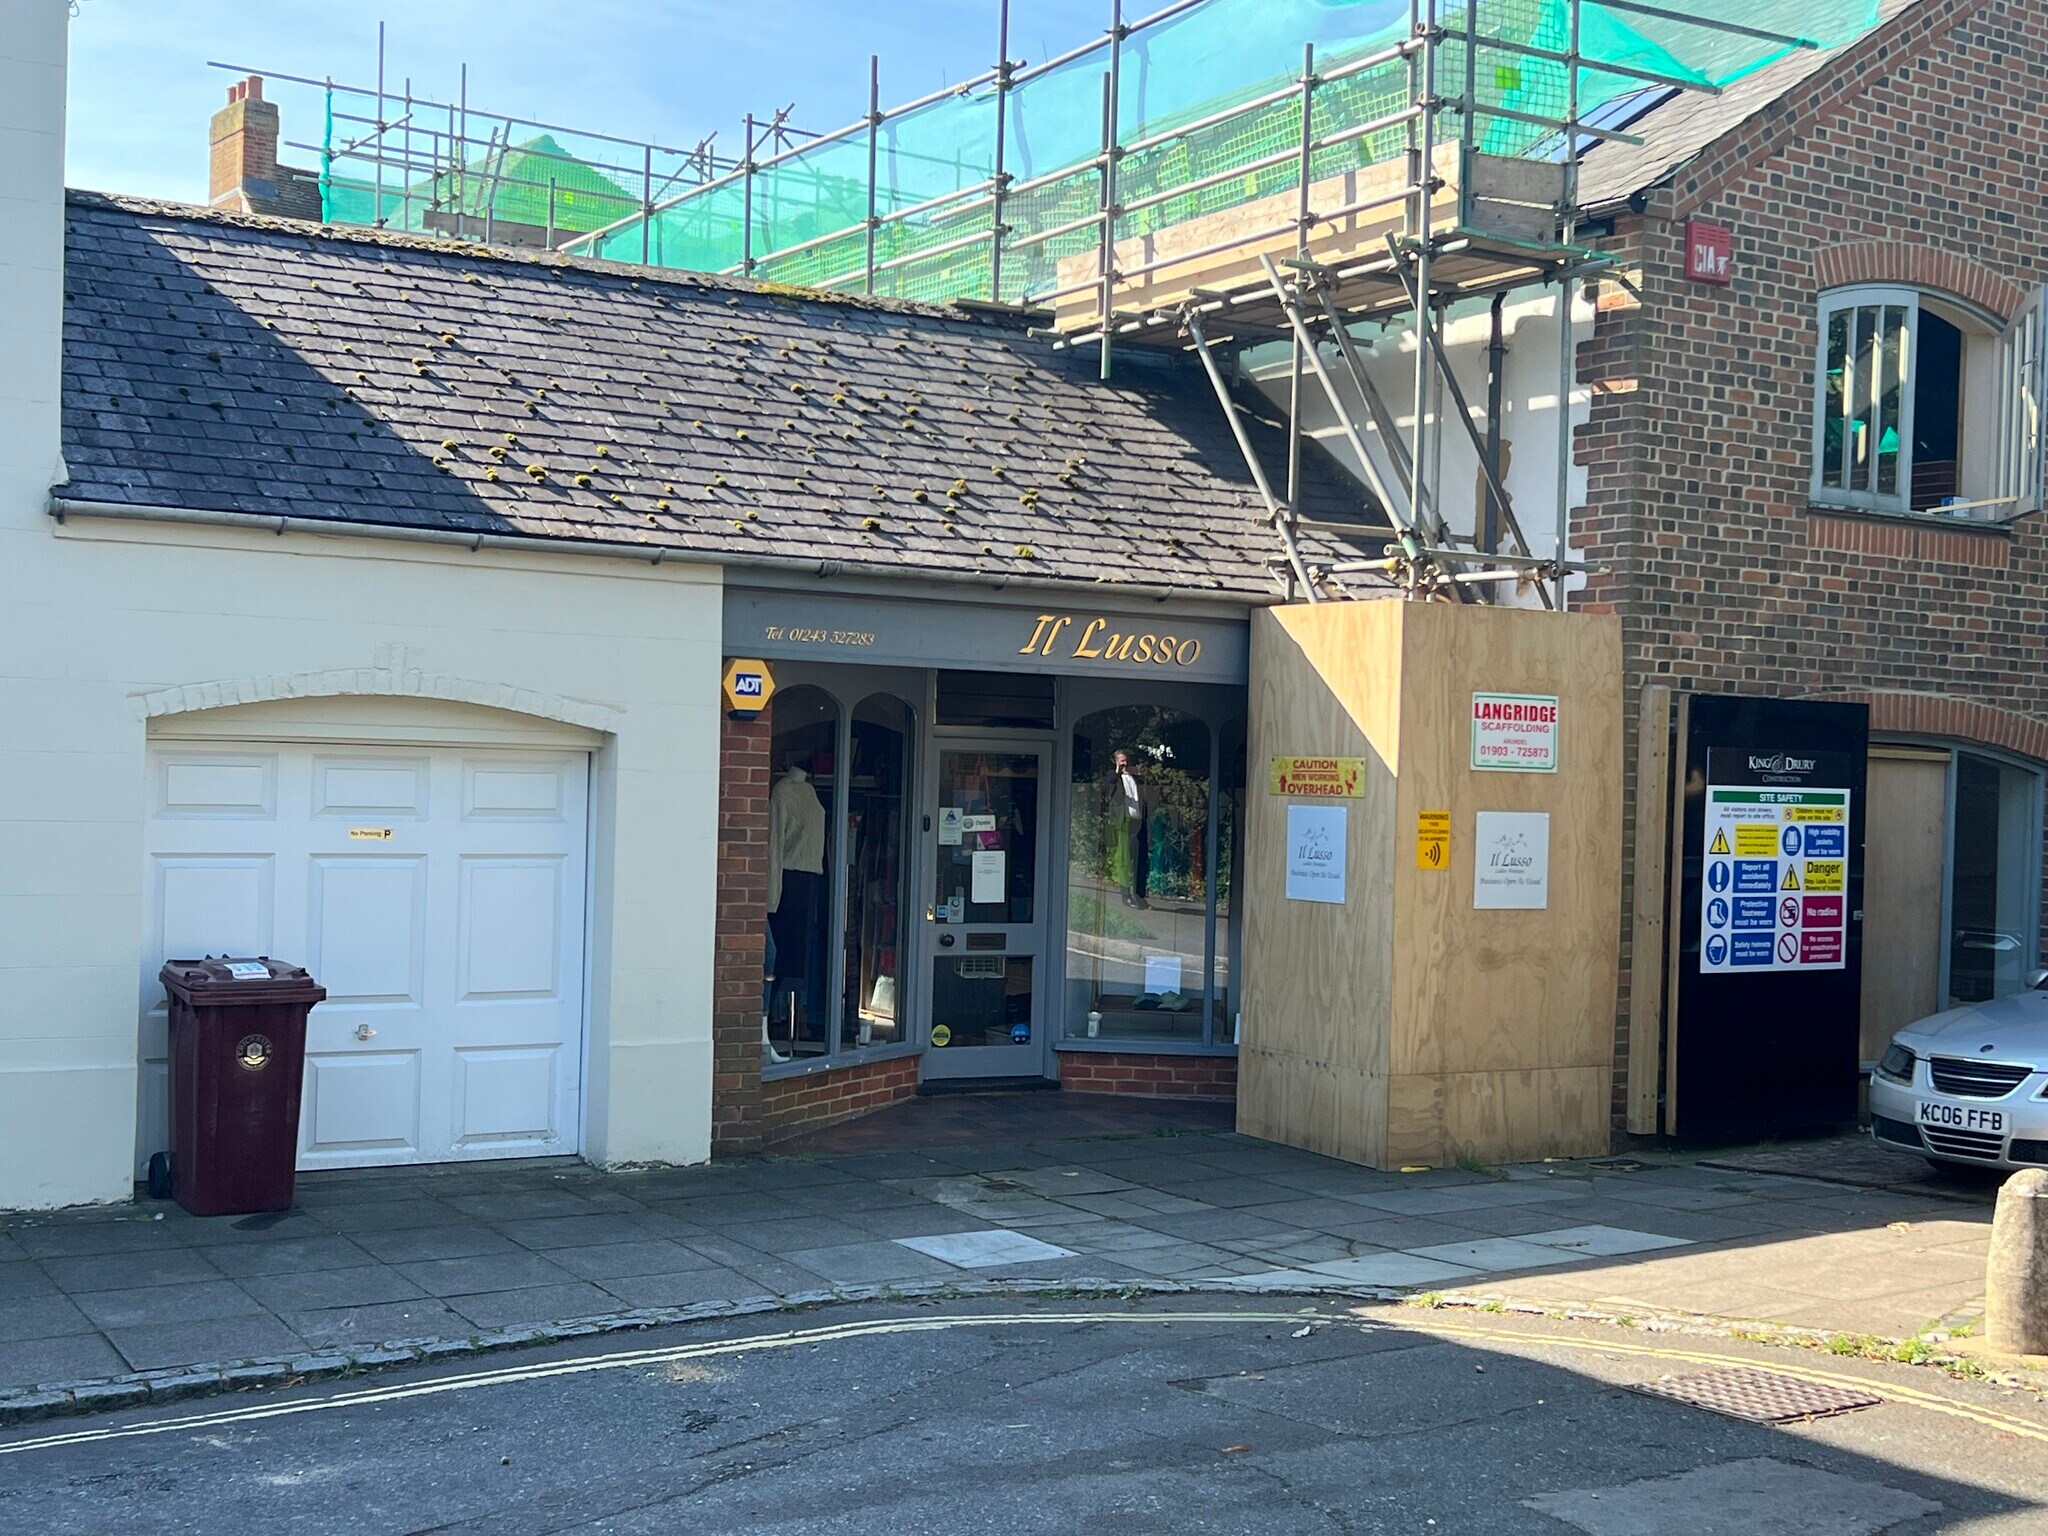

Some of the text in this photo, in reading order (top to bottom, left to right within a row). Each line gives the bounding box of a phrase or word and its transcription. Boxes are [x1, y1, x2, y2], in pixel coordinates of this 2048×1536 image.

[1694, 244, 1715, 274] CIA
[789, 628, 826, 643] 01243
[829, 631, 875, 646] 527283
[1018, 614, 1201, 666] Il Lusso
[735, 677, 763, 693] ADT
[1474, 702, 1557, 723] LANGRIDGE
[1481, 721, 1550, 733] SCAFFOLDING
[1480, 745, 1508, 757] 01903
[1517, 746, 1549, 758] 725873
[1292, 760, 1338, 770] CAUTION
[1748, 755, 1771, 769] KING
[1785, 757, 1816, 770] DRURY
[1308, 774, 1340, 782] WORKING
[1287, 783, 1343, 795] OVERHEAD
[1759, 793, 1804, 803] SITE SAFETY
[1808, 828, 1820, 837] High
[1307, 847, 1333, 861] Lusso
[1490, 851, 1533, 867] Il Lusso
[1741, 863, 1770, 872] Report all
[1807, 862, 1841, 877] Danger
[1741, 872, 1770, 880] accidents
[1502, 878, 1517, 888] Open
[1740, 900, 1769, 908] Protective
[1741, 909, 1767, 917] footwear
[1806, 907, 1838, 917] No radios
[1734, 918, 1749, 926] must
[1749, 918, 1758, 926] be
[1734, 941, 1751, 950] Safety
[1735, 950, 1749, 958] must
[1920, 1102, 2003, 1131] KC06 FFB
